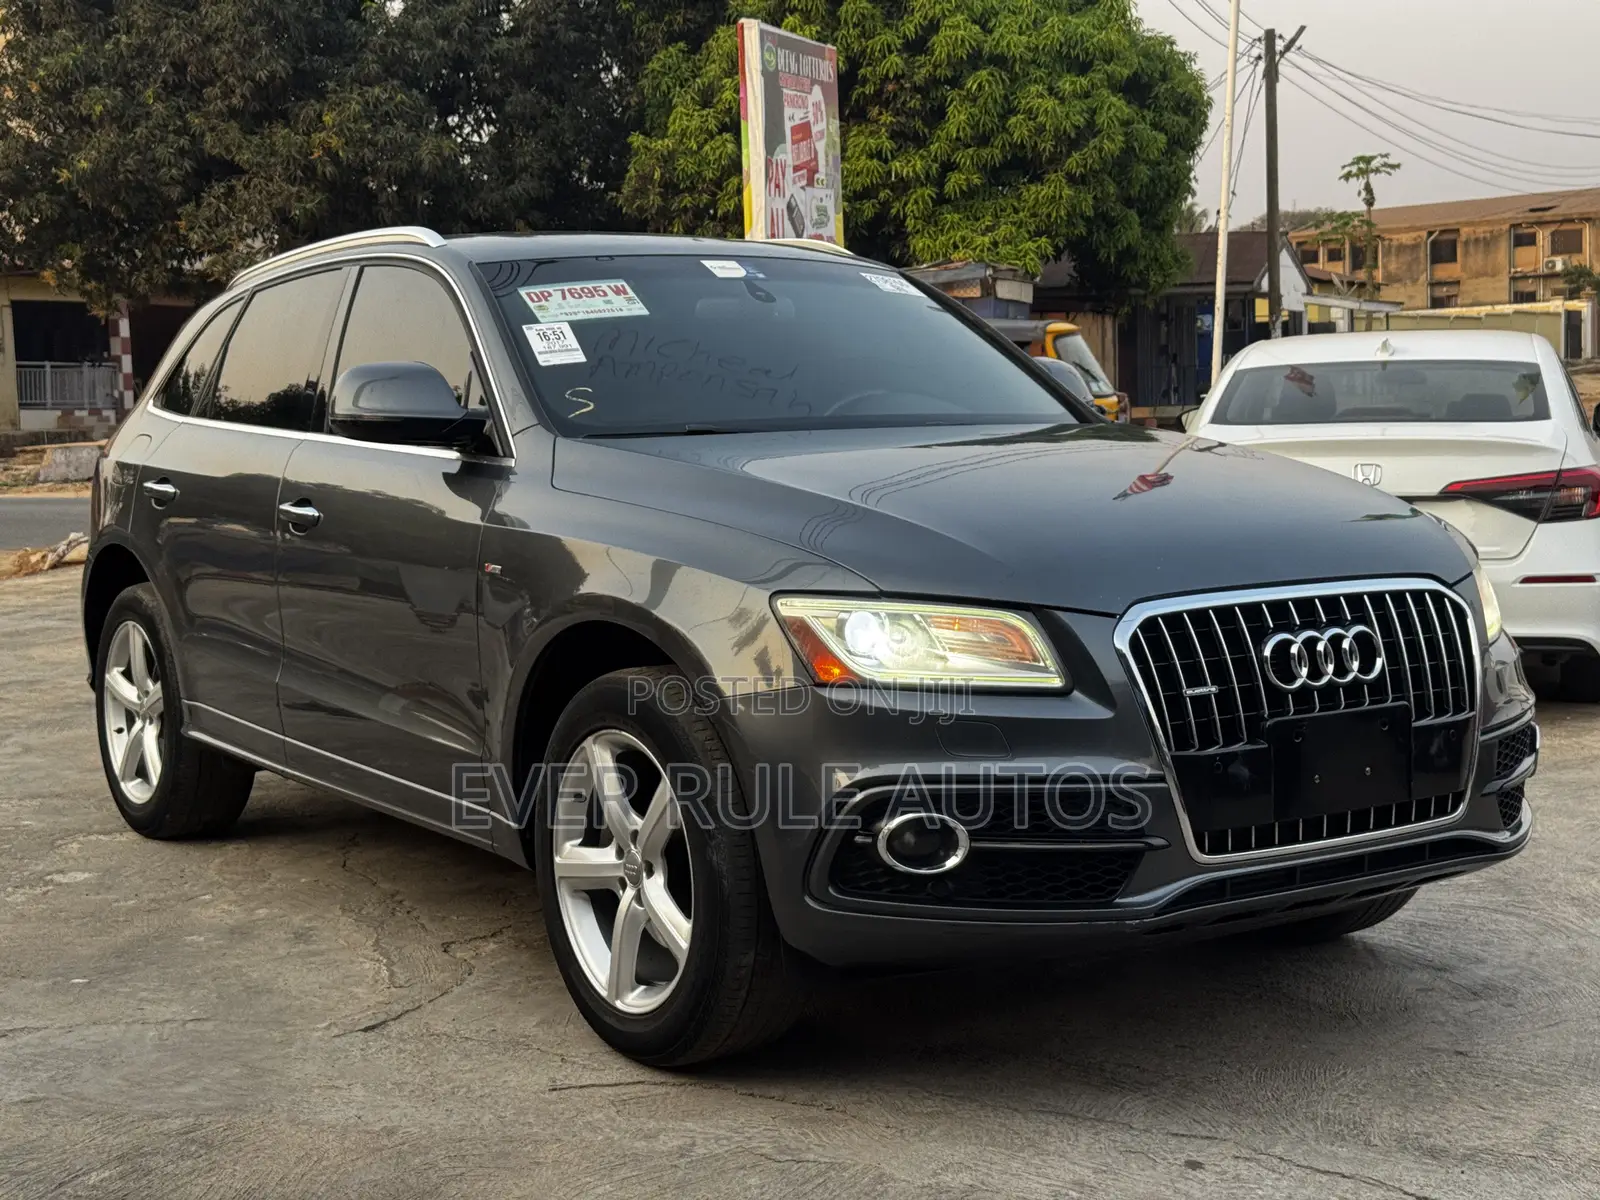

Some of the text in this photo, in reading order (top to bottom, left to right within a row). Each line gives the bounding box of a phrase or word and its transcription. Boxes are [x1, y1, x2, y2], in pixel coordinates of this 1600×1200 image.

[767, 156, 787, 198] PAY
[525, 284, 630, 304] DP 7695 W
[536, 330, 567, 342] 16:51
[565, 387, 595, 418] S
